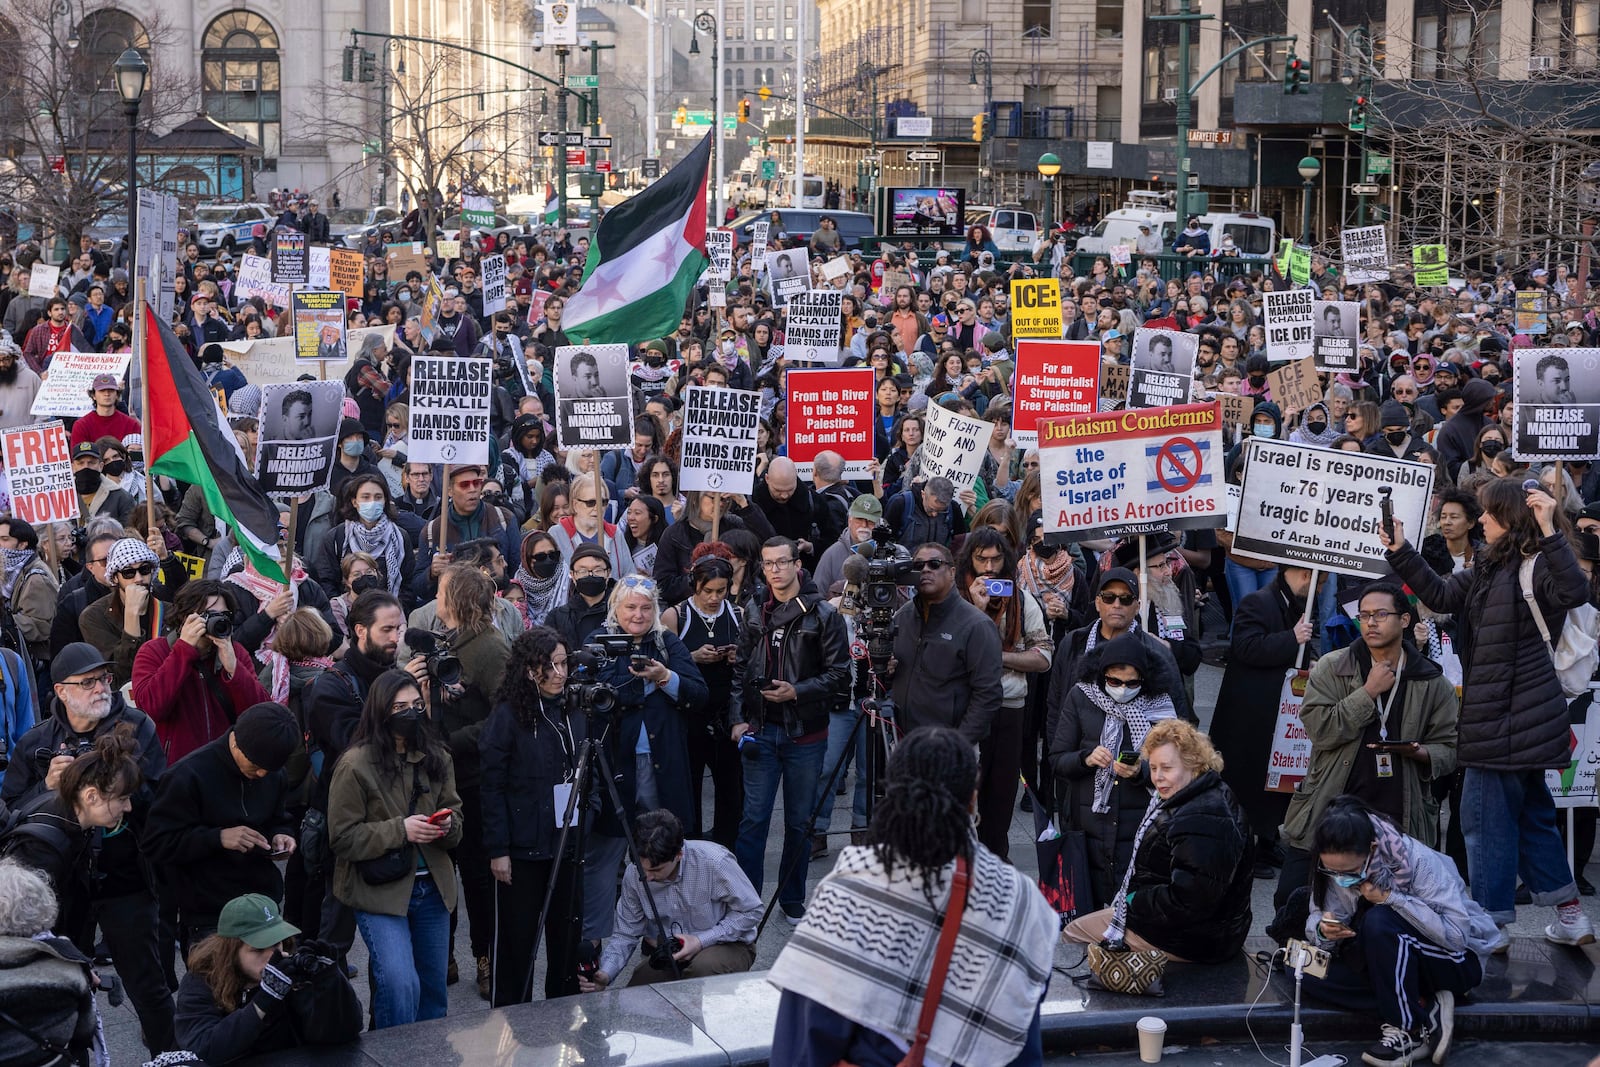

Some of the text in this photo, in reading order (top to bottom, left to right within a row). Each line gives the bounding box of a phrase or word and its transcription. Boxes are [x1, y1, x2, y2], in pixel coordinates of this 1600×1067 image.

[1189, 131, 1230, 142] LAFAYETTE ST
[705, 233, 731, 243] ANDS
[1345, 228, 1383, 242] RELEASE
[1346, 239, 1383, 249] MAHMOUD
[1347, 247, 1384, 256] KHALIL
[331, 258, 361, 268] FASCIST
[334, 265, 359, 274] TRUMP
[332, 272, 360, 281] REGIME
[336, 279, 356, 287] MUST
[779, 279, 802, 288] RELEASE
[777, 285, 807, 296] MAHMOUD
[1015, 285, 1057, 308] ICE:
[790, 293, 841, 306] RELEASE
[1267, 292, 1311, 307] RELEASE
[789, 306, 840, 317] MAHMOUD
[1268, 305, 1312, 317] MAHMOUD
[789, 317, 839, 325] KHALIL
[1015, 317, 1059, 326] OUT OF OUR
[1269, 315, 1312, 324] KHALIL
[788, 328, 838, 339] HANDS OFF
[1270, 328, 1289, 342] ICE
[787, 337, 838, 347] OUR STUDENTS
[1322, 338, 1349, 347] RELEASE
[55, 354, 72, 362] FREE
[1318, 347, 1353, 357] MAHMOUD
[1325, 356, 1346, 365] KHALIL
[414, 360, 490, 381] RELEASE
[1042, 363, 1073, 374] For an
[1278, 363, 1304, 384] ICE
[1020, 375, 1094, 388] Anti-Imperialist
[1145, 373, 1180, 388] RELEASE
[413, 380, 489, 397] MAHMOUD
[1030, 388, 1082, 400] Struggle to
[1138, 383, 1183, 399] MAHMOUD
[1280, 381, 1301, 397] OFF
[689, 389, 761, 413] RELEASE
[793, 389, 869, 402] From the River
[412, 396, 489, 409] KHALIL
[573, 402, 615, 414] RELEASE
[1020, 400, 1091, 413] Free Palestine!
[1225, 397, 1242, 408] ICE
[803, 404, 859, 416] to the Sea,
[1224, 409, 1241, 420] OFF
[1535, 409, 1584, 422] RELEASE
[413, 414, 488, 430] HANDS OFF
[568, 414, 622, 427] MAHMOUD
[687, 409, 757, 428] MAHMOUD
[806, 418, 854, 430] Palestine
[931, 407, 982, 437] TO FIGHT
[1045, 408, 1215, 441] Judaism Condemns
[580, 427, 613, 439] KHALIL
[687, 425, 756, 440] KHALIL
[1527, 422, 1592, 436] MAHMOUD
[412, 430, 487, 442] OUR STUDENTS
[794, 431, 867, 444] Red and Free!
[926, 420, 976, 452] TRUMP AND
[1538, 436, 1579, 449] KHALIL
[6, 426, 68, 468] FREE
[276, 444, 323, 459] RELEASE
[685, 442, 755, 461] HANDS OFF
[953, 453, 963, 466] A
[1076, 448, 1105, 464] the
[10, 462, 70, 476] PALESTINE
[267, 457, 326, 473] MAHMOUD
[683, 457, 753, 473] OUR STUDENTS
[1253, 445, 1427, 488] Israel is responsible
[12, 472, 72, 489] END THE
[276, 472, 314, 487] KHALIL
[1056, 462, 1126, 486] State of
[13, 482, 73, 496] OCCUPATION
[1280, 480, 1374, 508] for 76 years
[14, 488, 77, 524] NOW!
[1057, 495, 1216, 528] And its Atrocities
[1259, 500, 1381, 535] tragic bloodsh
[1104, 522, 1169, 536] www.NKUSA.org
[1271, 529, 1286, 539] of
[1287, 530, 1321, 546] Arab
[1324, 538, 1351, 551] and
[1285, 548, 1363, 569] www.NKUSA.org
[1285, 723, 1310, 739] Zionis
[1272, 751, 1302, 768] State of
